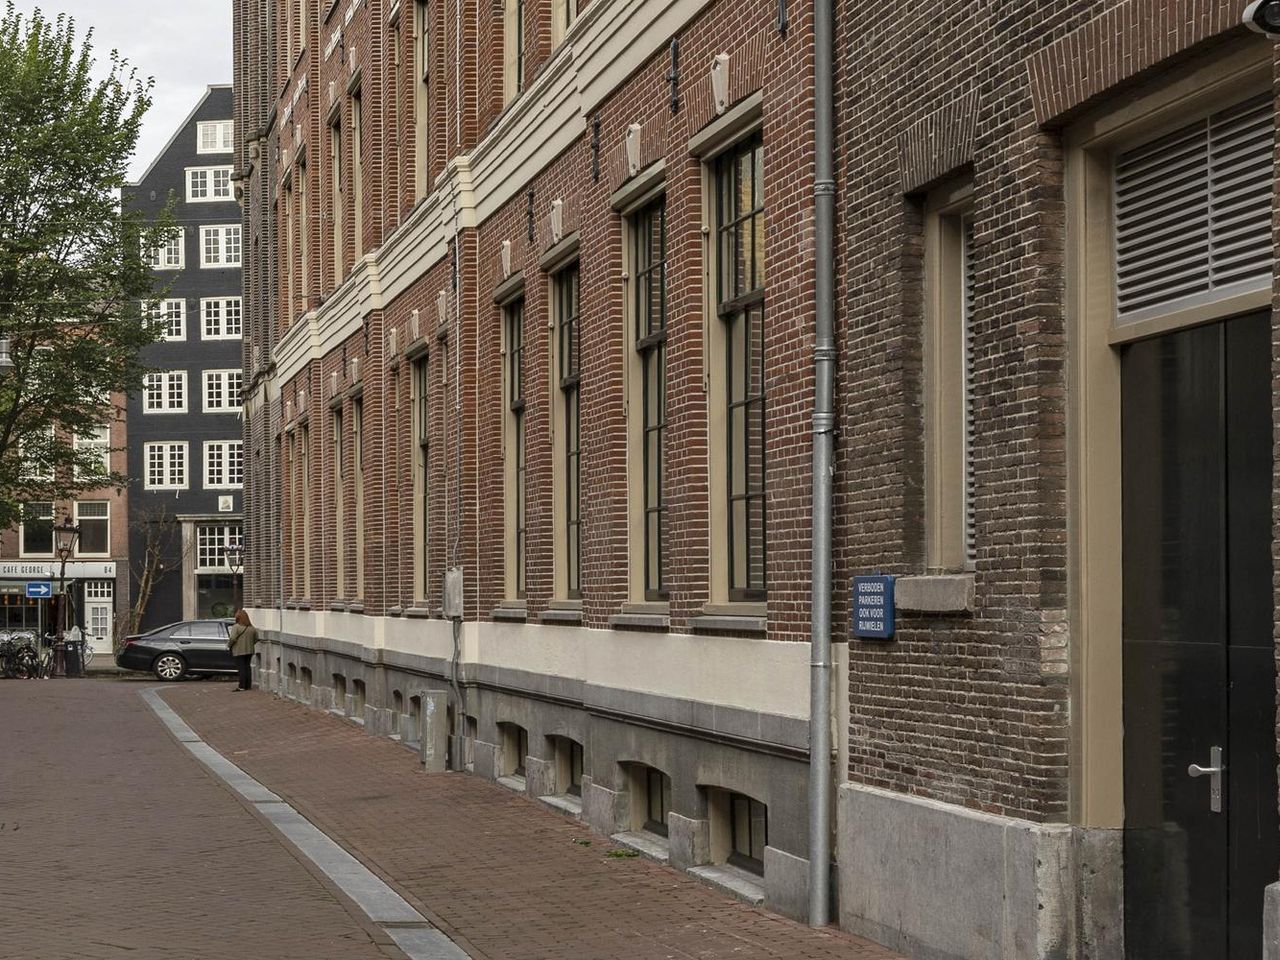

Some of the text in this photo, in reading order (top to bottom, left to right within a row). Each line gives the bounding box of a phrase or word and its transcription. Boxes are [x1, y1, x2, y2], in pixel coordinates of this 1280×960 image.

[2, 565, 44, 574] CAFE GEORGE
[858, 582, 884, 592] VERBODEN
[858, 595, 884, 605] PARKEREN
[858, 608, 884, 618] OOK VOOR
[858, 620, 884, 631] RIJWIELEN
